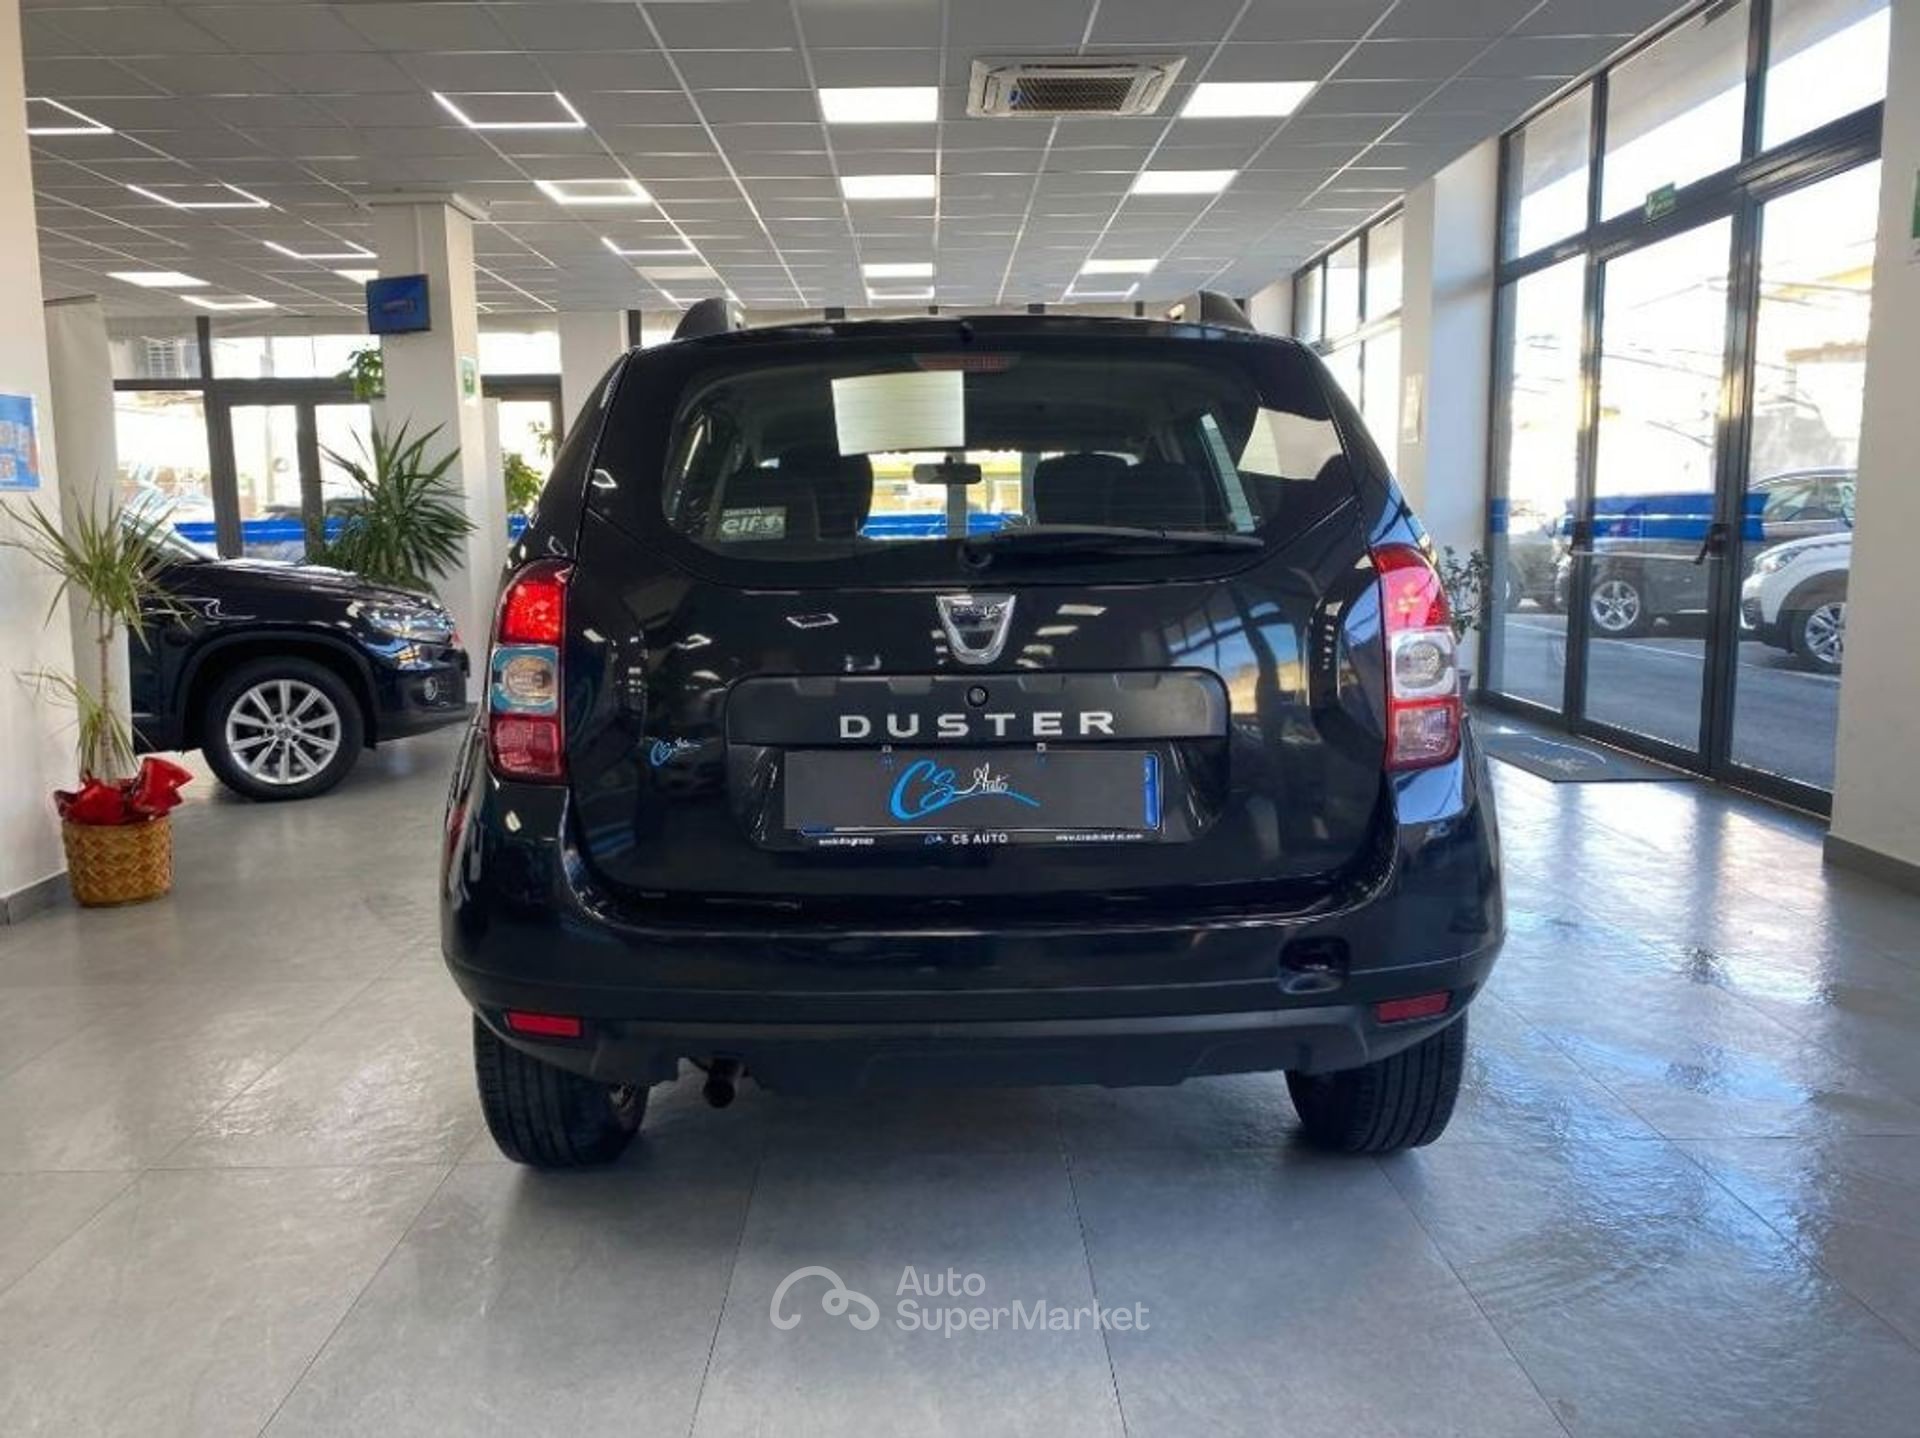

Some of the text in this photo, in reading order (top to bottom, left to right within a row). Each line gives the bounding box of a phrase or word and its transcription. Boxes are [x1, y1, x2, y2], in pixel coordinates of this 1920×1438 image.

[722, 516, 761, 533] elf
[839, 711, 1115, 739] DUSTER
[972, 833, 1009, 845] AUTO
